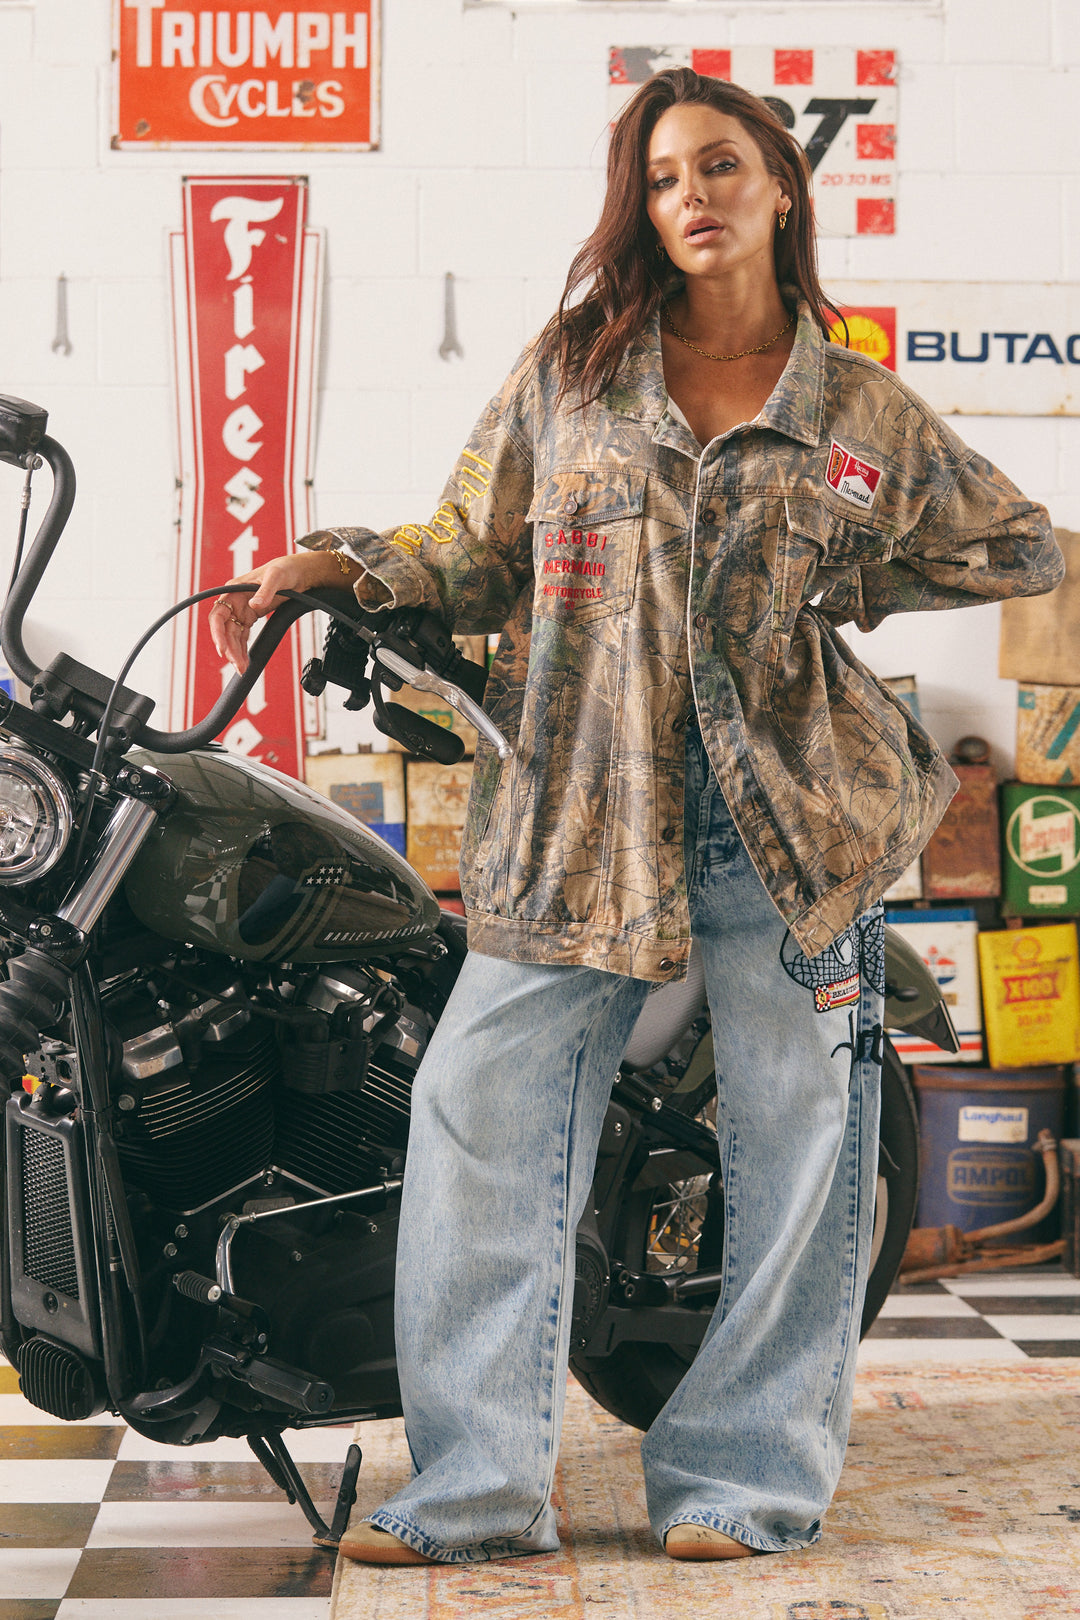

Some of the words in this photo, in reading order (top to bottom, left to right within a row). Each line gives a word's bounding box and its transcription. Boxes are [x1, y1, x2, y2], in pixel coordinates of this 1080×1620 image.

[124, 0, 368, 68] TRIUMPH
[189, 75, 345, 127] CYCLES
[545, 529, 607, 551] SABBI
[544, 560, 605, 576] MERMAID
[543, 584, 603, 599] MOTORCYCLE
